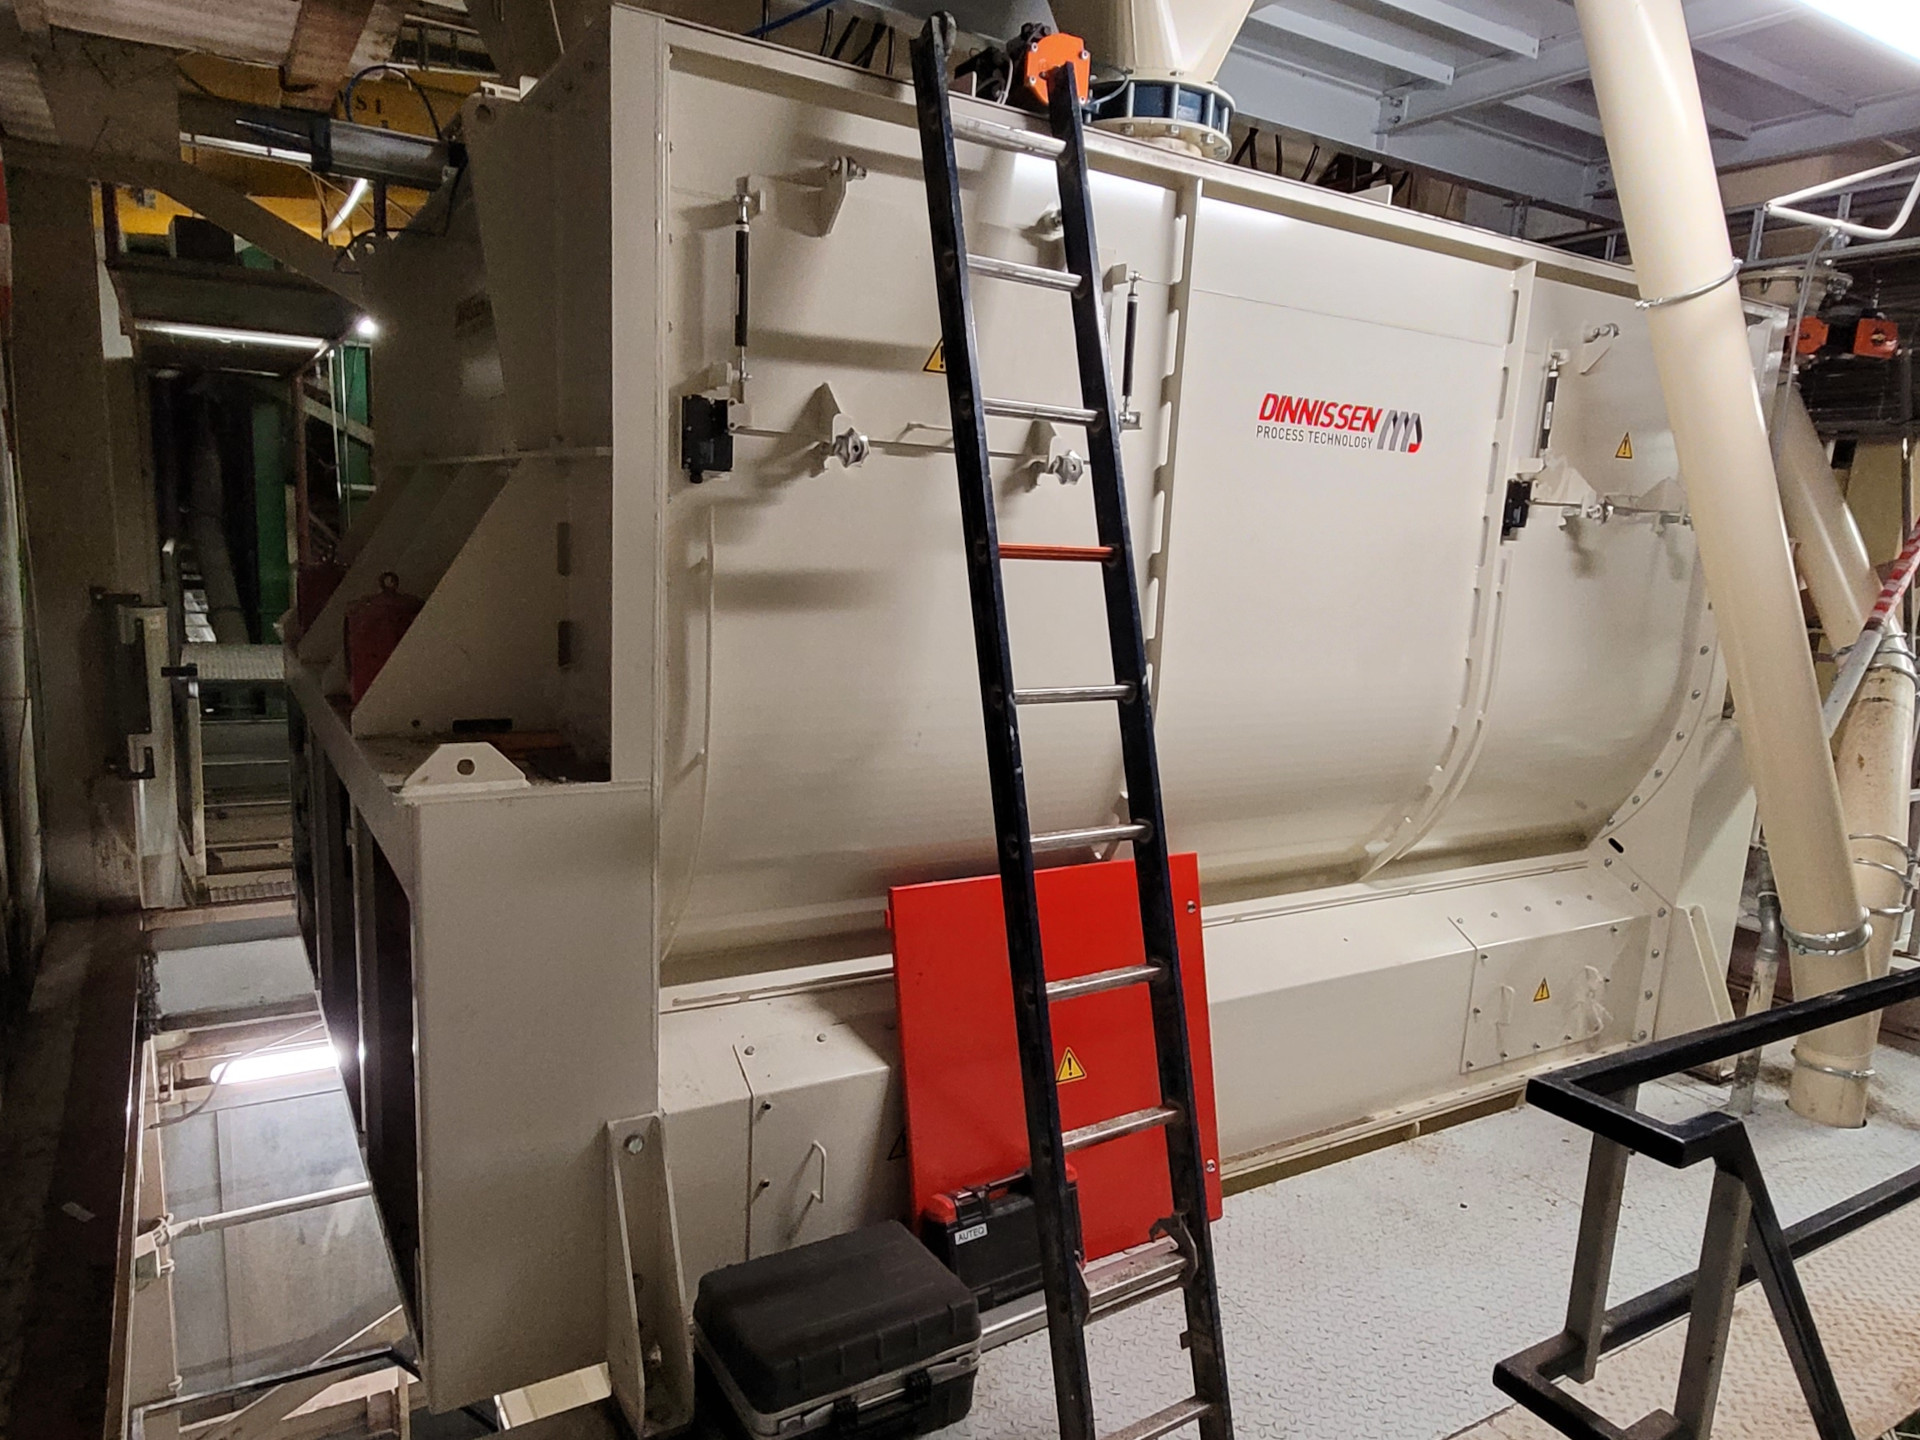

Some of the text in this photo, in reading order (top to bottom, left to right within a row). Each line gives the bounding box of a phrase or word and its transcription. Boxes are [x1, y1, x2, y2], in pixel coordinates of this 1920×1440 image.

[1258, 392, 1383, 433] DINNISSEN
[1256, 425, 1373, 450] PROCESS TECHNOLOGY
